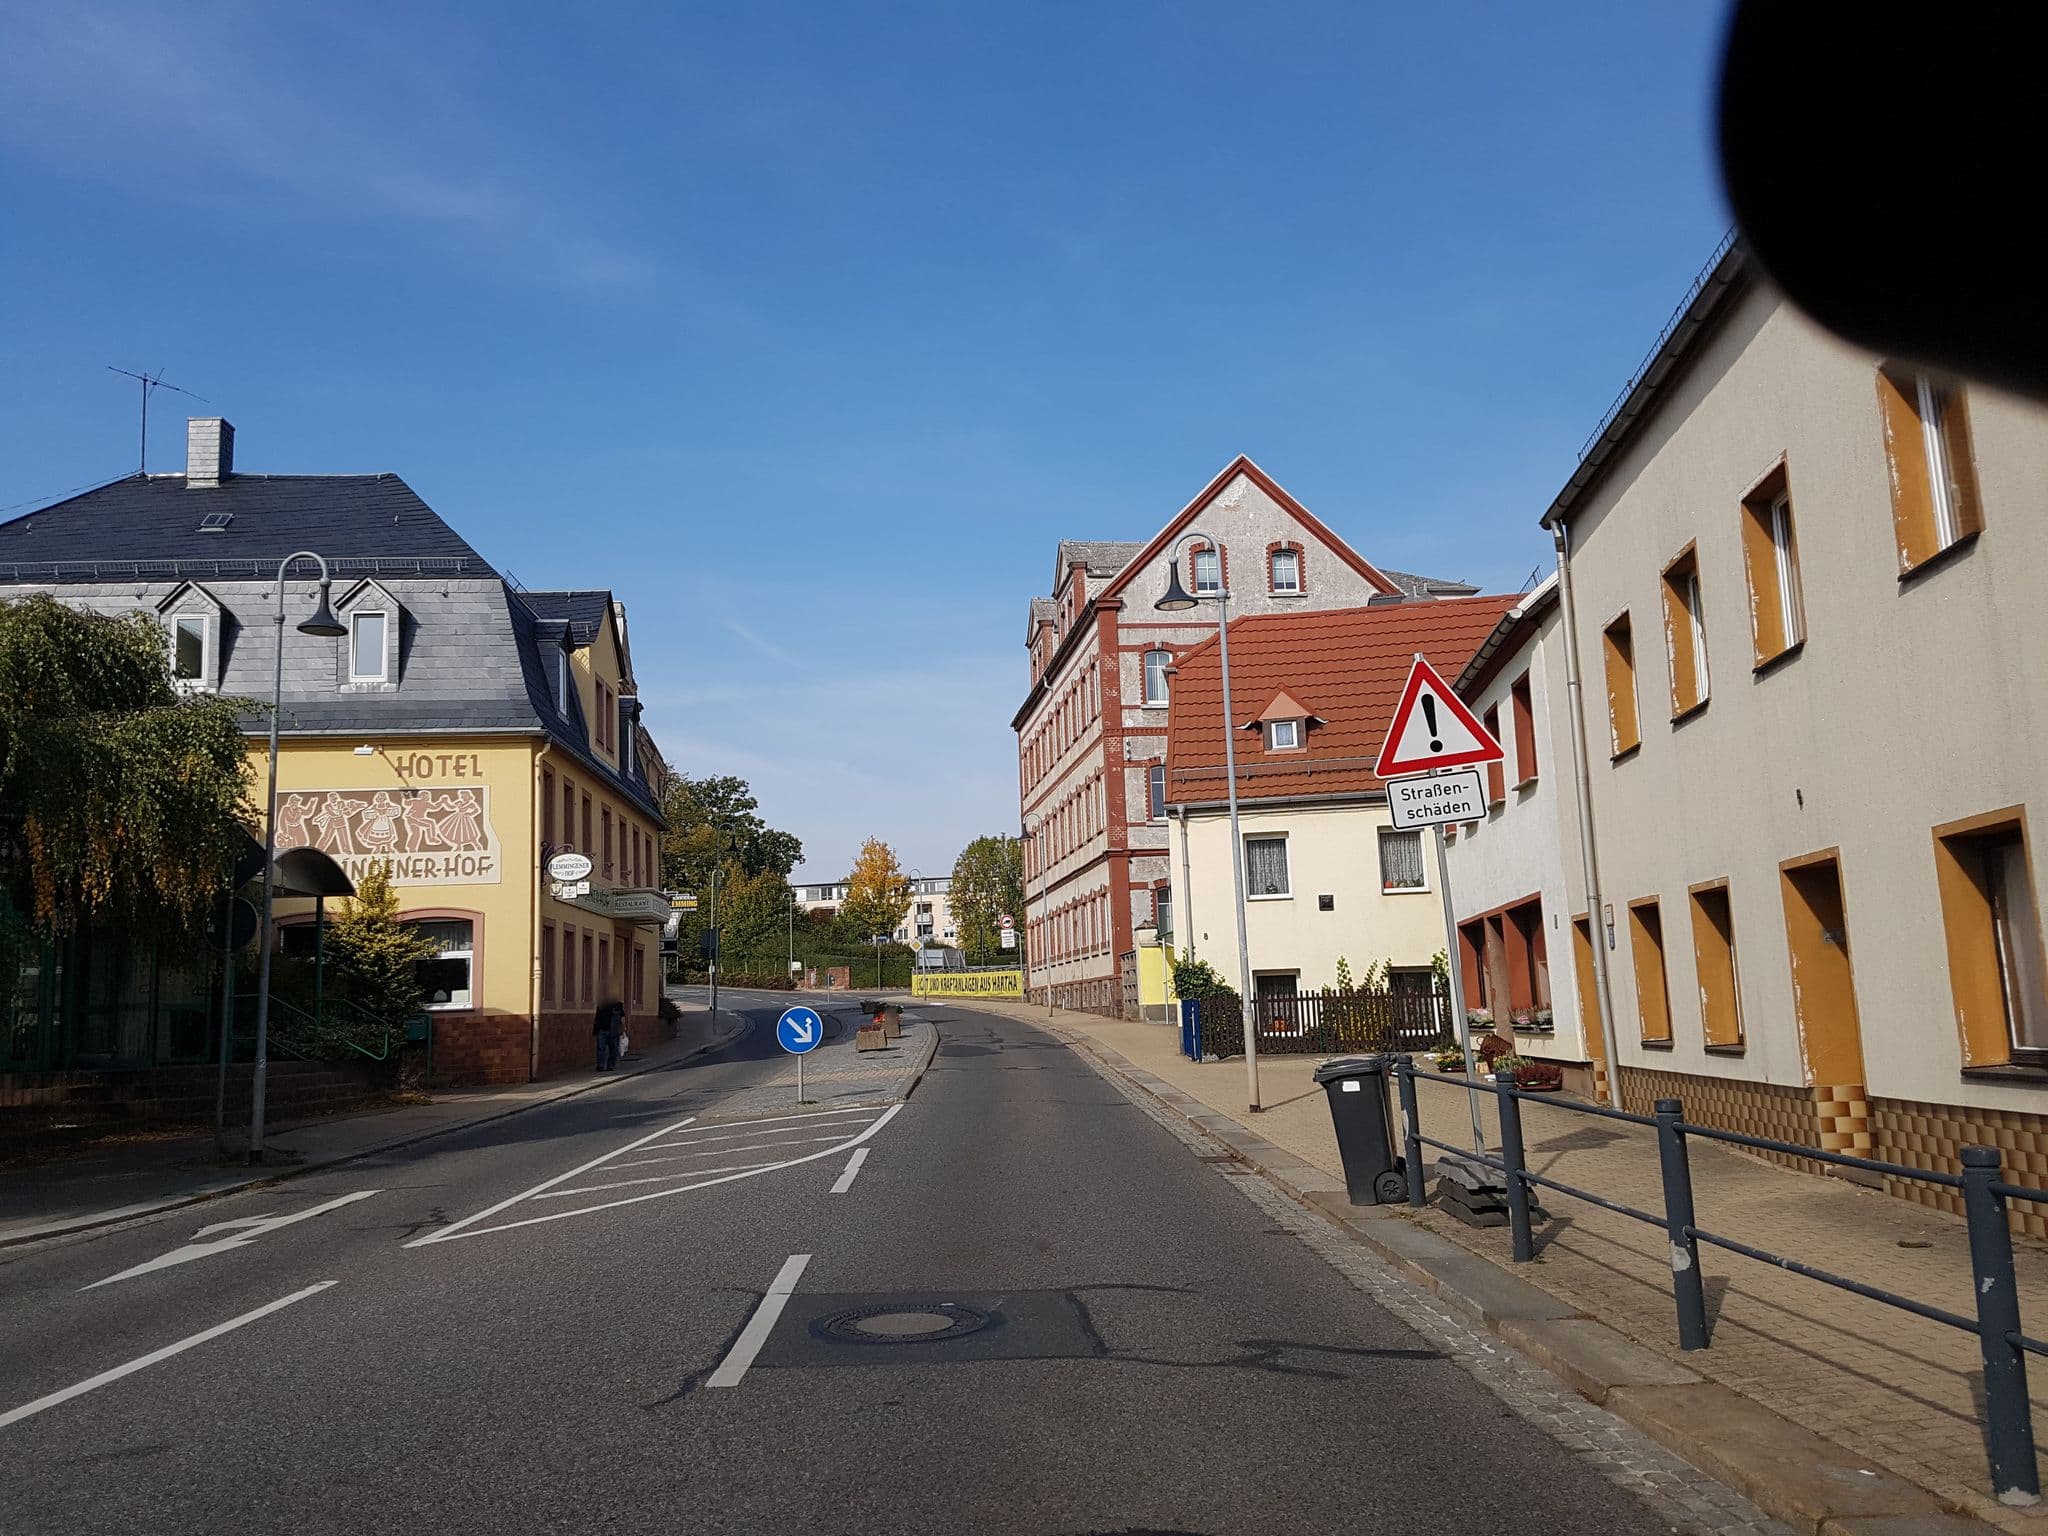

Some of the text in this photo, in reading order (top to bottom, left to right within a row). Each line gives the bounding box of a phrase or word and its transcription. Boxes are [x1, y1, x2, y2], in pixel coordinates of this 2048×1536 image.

[396, 751, 483, 779] HOTEL
[1400, 783, 1469, 801] Straßen-
[1406, 801, 1471, 820] schäden
[979, 976, 991, 992] AUS
[992, 975, 1018, 992] HARTHA
